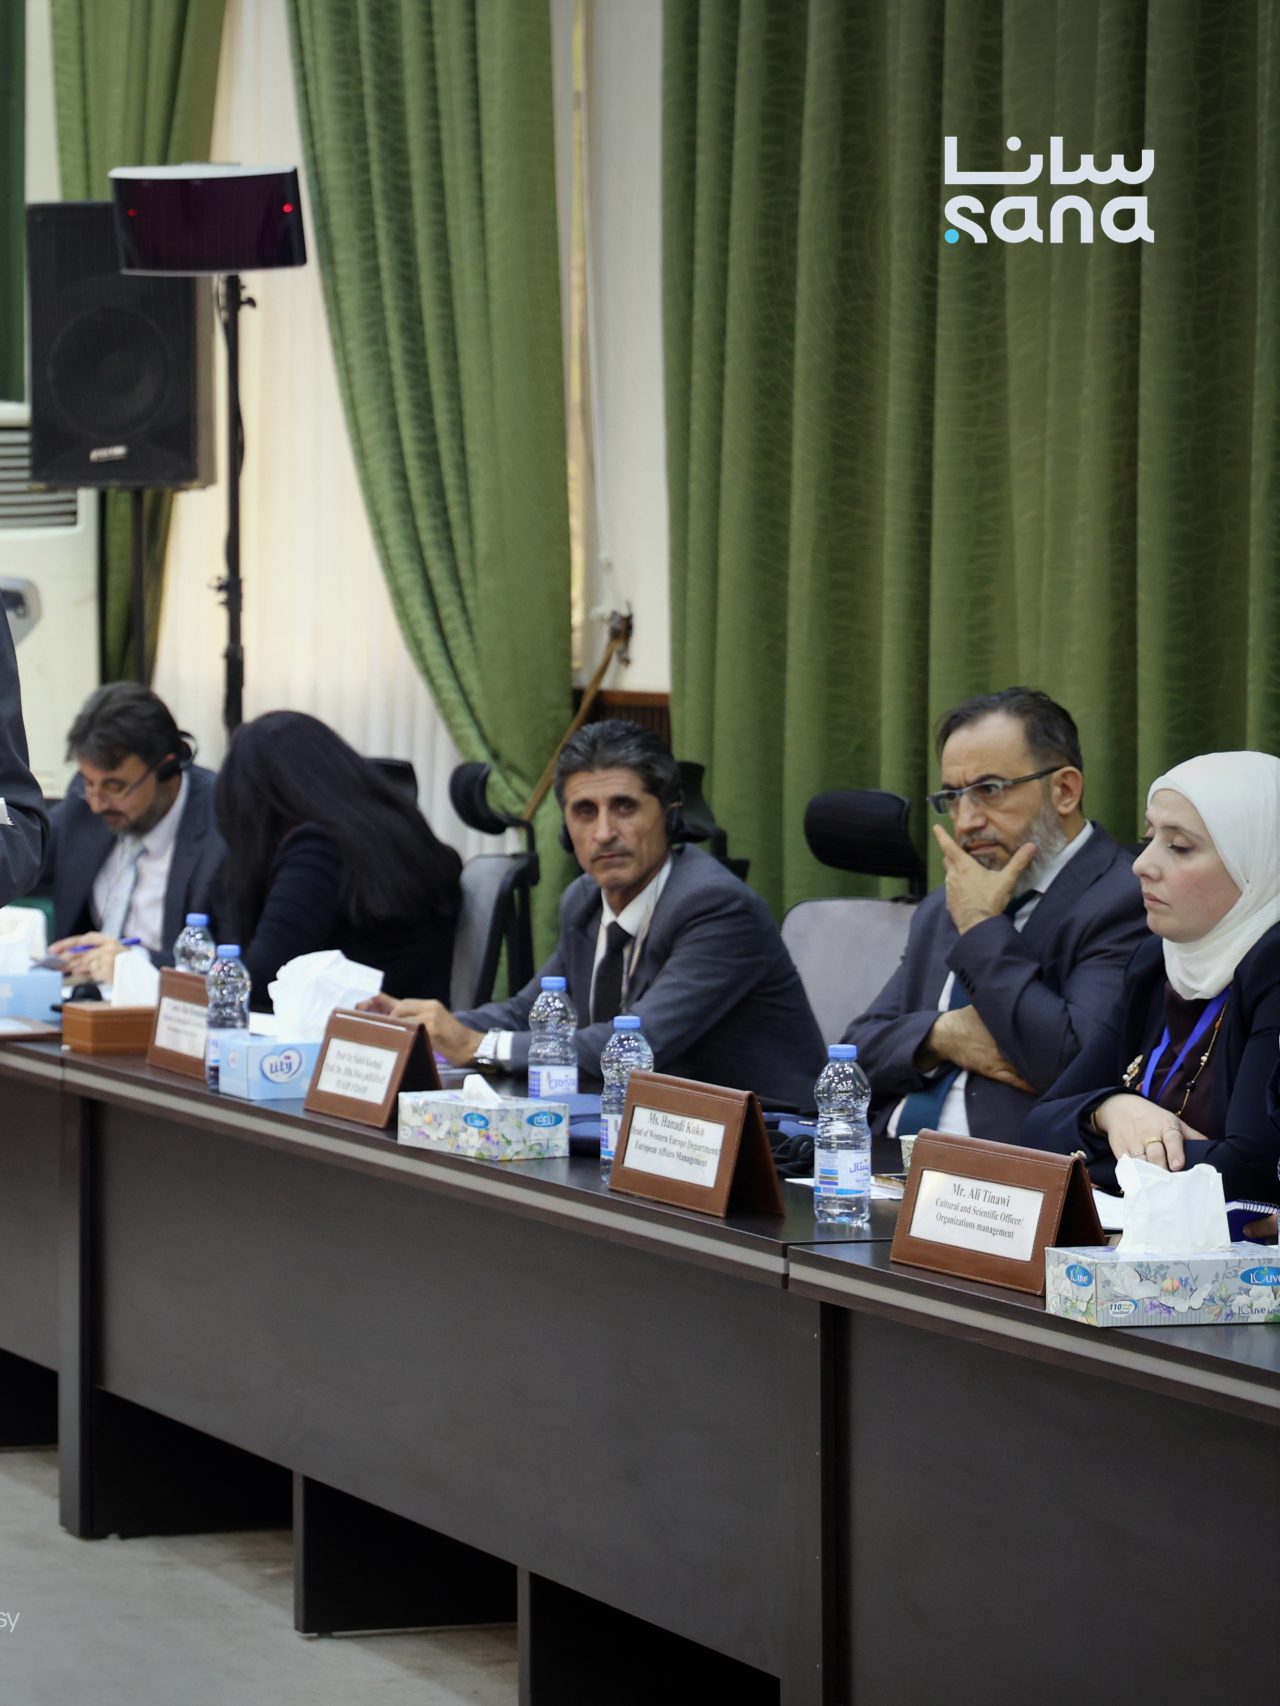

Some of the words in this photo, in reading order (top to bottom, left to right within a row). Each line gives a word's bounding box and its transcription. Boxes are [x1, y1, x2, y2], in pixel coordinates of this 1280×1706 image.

[952, 1183, 966, 1198] Mr.
[969, 1186, 981, 1202] Ali
[982, 1189, 1011, 1208] Tinawi
[935, 1197, 959, 1211] Cultural
[960, 1203, 971, 1214] and
[972, 1206, 998, 1221] Scientific
[935, 1212, 975, 1230] Organizations
[976, 1223, 1014, 1239] management
[1110, 1303, 1122, 1311] 110
